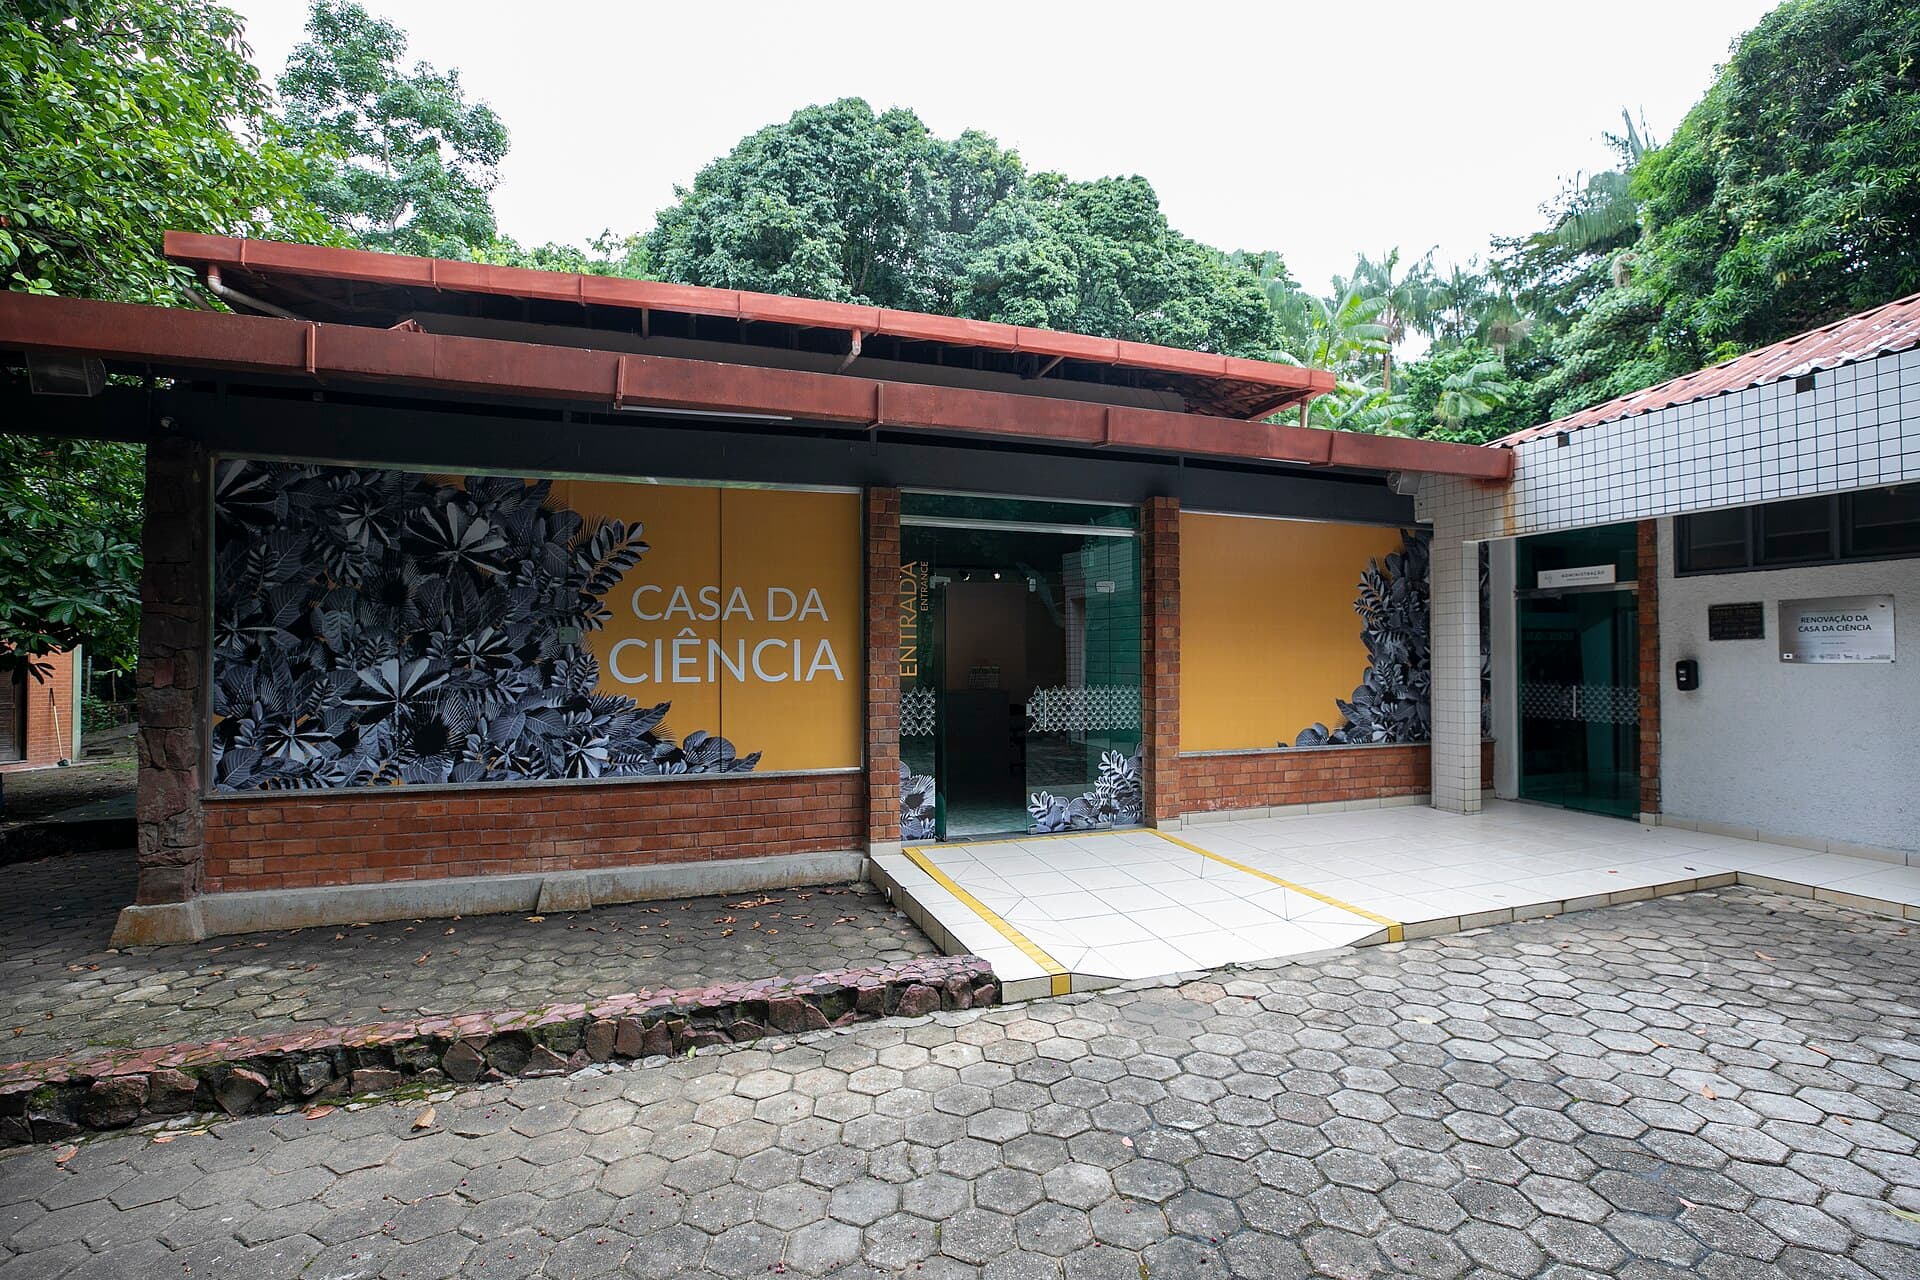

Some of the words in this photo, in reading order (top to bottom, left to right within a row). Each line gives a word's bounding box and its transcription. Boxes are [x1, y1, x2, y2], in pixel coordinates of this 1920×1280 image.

[631, 585, 754, 622] CASA
[767, 587, 829, 622] DA
[920, 561, 929, 612] ENTRANCE
[899, 561, 918, 677] ENTRADA
[1800, 614, 1853, 624] RENOVAÇÃO
[1836, 624, 1872, 632] CIÊNCIA
[608, 627, 844, 684] CIÊNCIA
